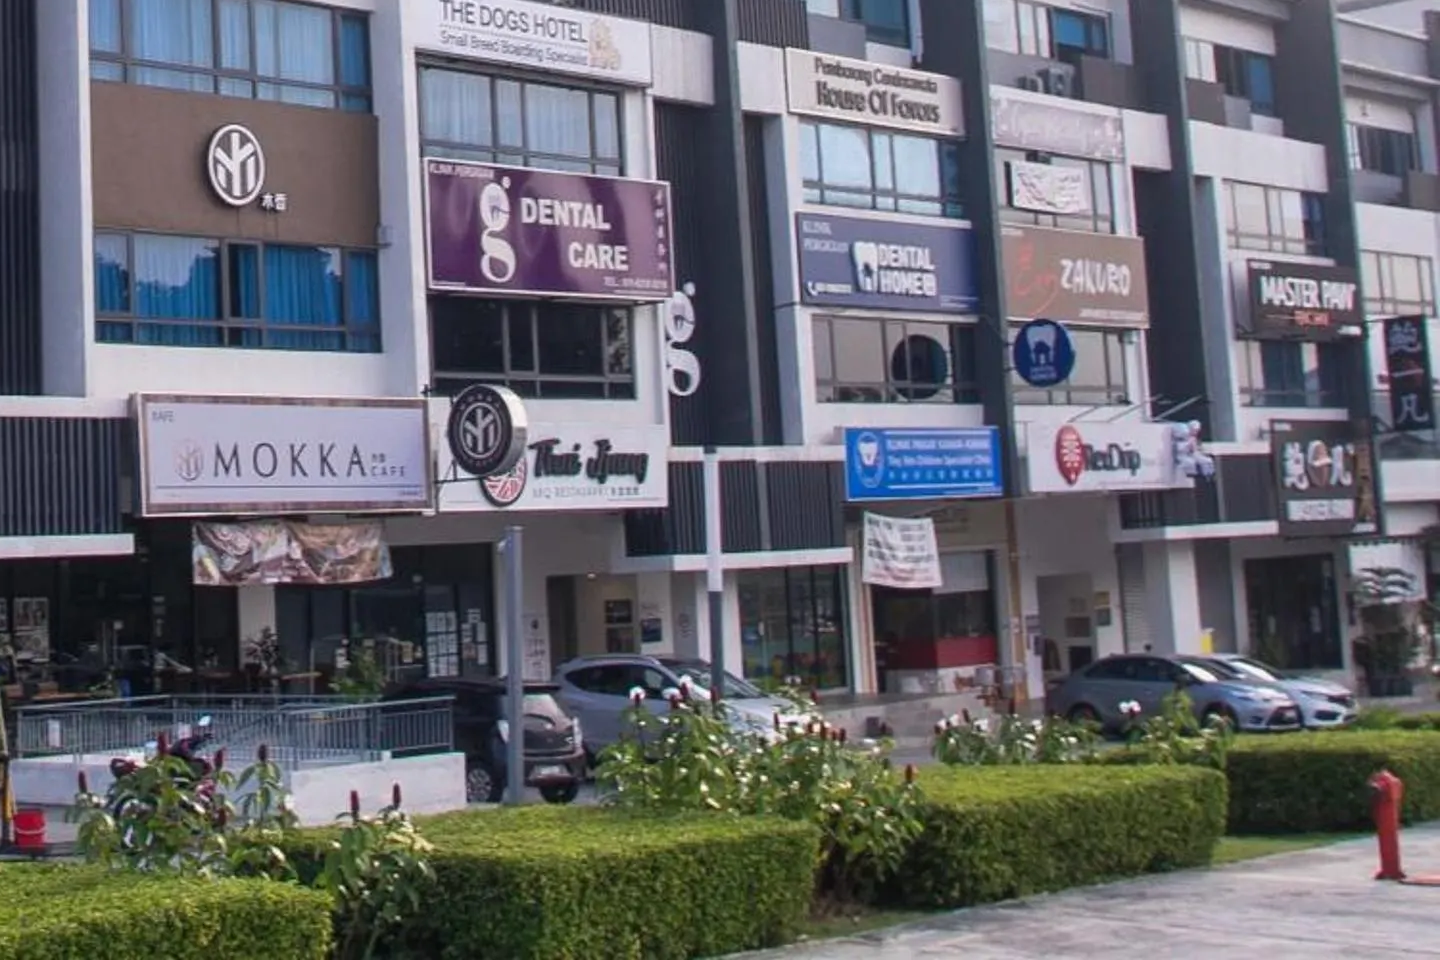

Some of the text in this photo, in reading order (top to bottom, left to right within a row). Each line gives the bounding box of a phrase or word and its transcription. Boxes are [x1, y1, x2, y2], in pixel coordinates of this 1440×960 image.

[479, 5, 530, 35] DOGS
[533, 14, 589, 43] HOTEL
[440, 29, 468, 45] Small
[471, 35, 500, 53] Breed
[816, 80, 866, 112] House
[520, 197, 612, 231] DENTAL
[568, 241, 629, 271] CARE
[877, 243, 936, 271] DENTAL
[1261, 275, 1321, 309] MASTER
[212, 442, 368, 478] MOKKA
